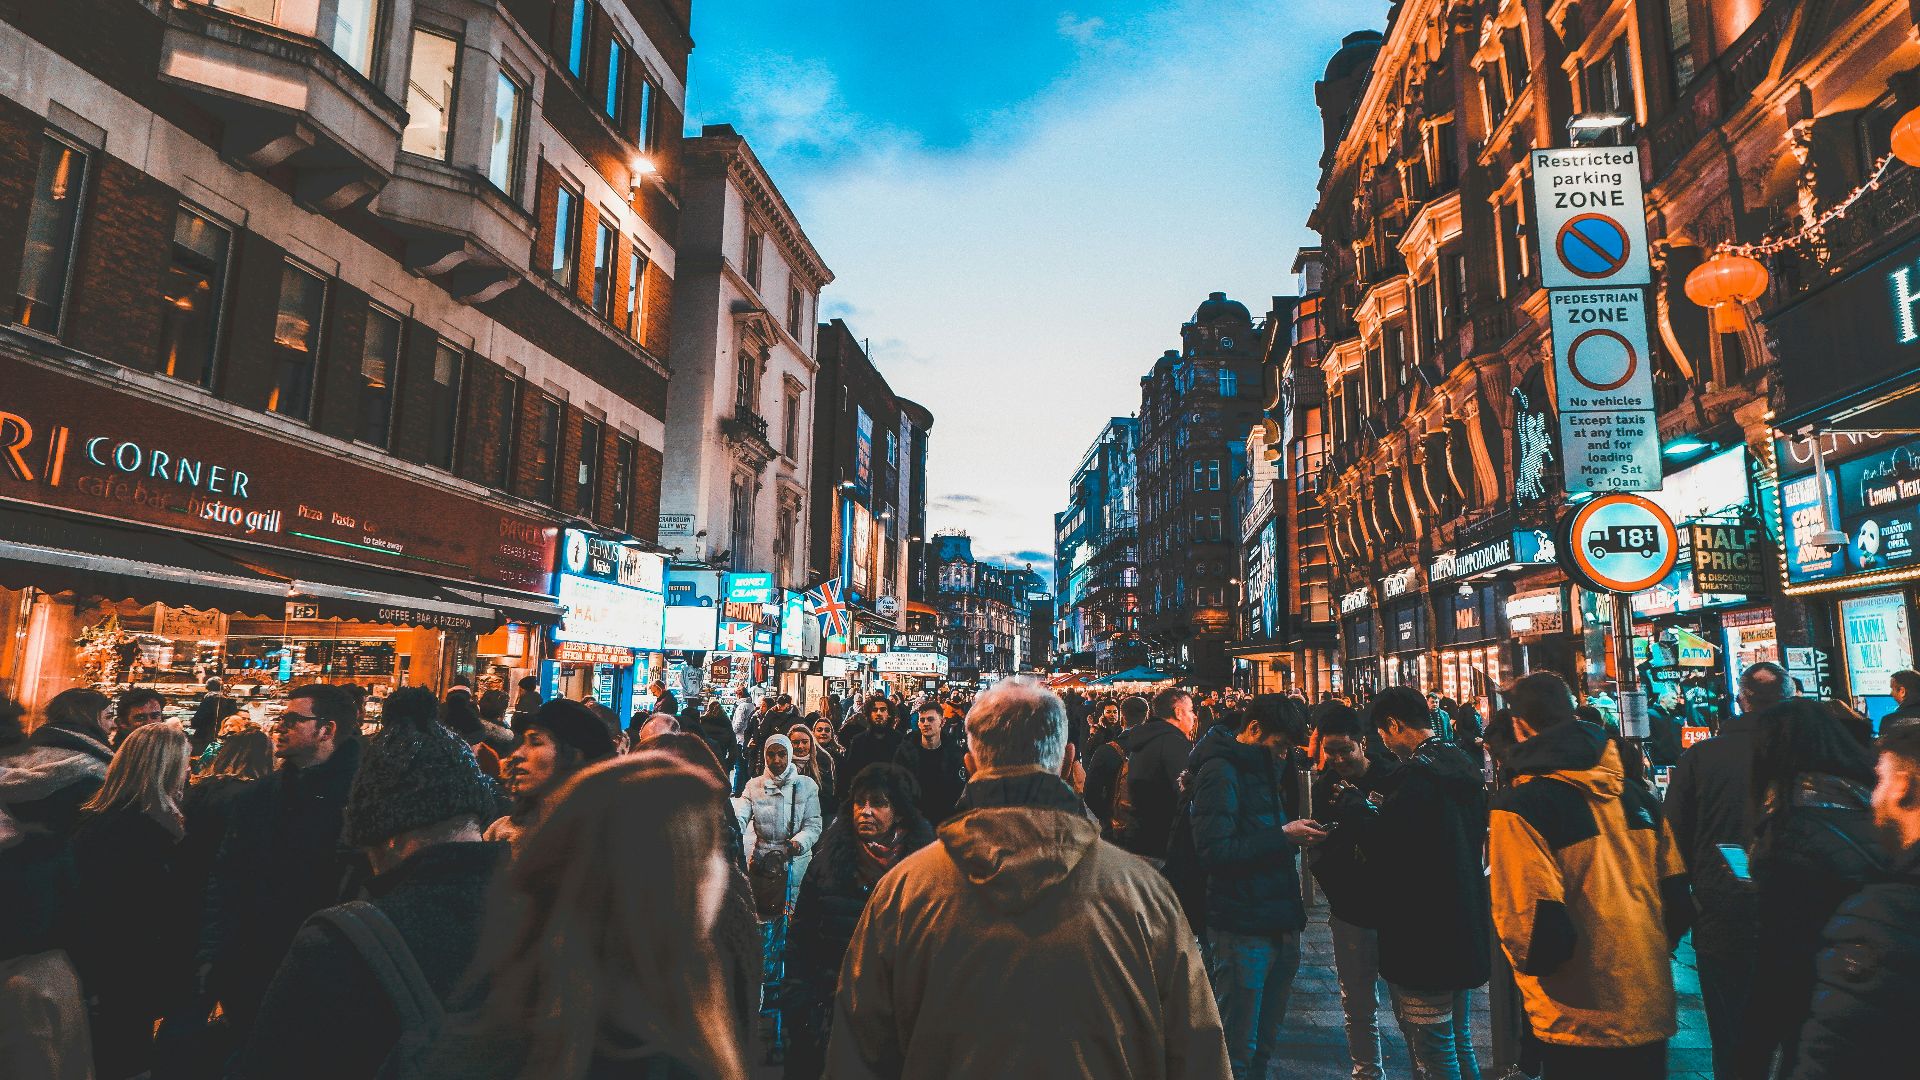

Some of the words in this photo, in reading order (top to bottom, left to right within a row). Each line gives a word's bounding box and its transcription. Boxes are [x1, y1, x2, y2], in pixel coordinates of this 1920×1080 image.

[1537, 150, 1634, 168] Restricted
[1553, 171, 1622, 188] parking
[1554, 190, 1625, 209] ZONE
[1555, 292, 1639, 305] PEDESTRIAN
[1568, 307, 1629, 324] ZONE
[1570, 397, 1588, 407] No
[1592, 396, 1642, 406] vehicles
[1569, 415, 1612, 427] Except
[1615, 414, 1646, 425] taxis
[1574, 429, 1587, 438] at
[1591, 429, 1612, 439] any
[1616, 428, 1644, 437] time
[1588, 440, 1610, 450] and
[1613, 440, 1632, 449] for
[86, 436, 249, 498] CORNER
[1588, 453, 1634, 464] loading
[1581, 466, 1608, 475] Mon
[1621, 465, 1642, 474] Sat
[1586, 478, 1594, 487] 6
[1607, 477, 1640, 487] 10am
[187, 495, 243, 526] bistro
[246, 509, 281, 534] grill
[298, 504, 323, 521] Pizza
[331, 511, 356, 529] Pasta
[1792, 505, 1824, 529] COM
[1881, 521, 1912, 536] PHANTOM
[363, 535, 371, 544] to
[371, 538, 387, 548] take
[386, 542, 404, 553] away
[1617, 528, 1653, 548] 18t
[1695, 527, 1757, 550] HALF
[1887, 538, 1909, 550] OPERA
[1456, 539, 1511, 577] HIPPODROME
[1697, 550, 1760, 570] PRICE
[1699, 573, 1706, 582] &
[1700, 582, 1733, 591] THEATRE
[379, 608, 410, 621] COFFEE
[416, 612, 431, 624] BAR
[440, 615, 471, 628] PIZZERIA
[726, 601, 762, 624] BRITAIN
[1741, 630, 1756, 641] ATM
[1756, 628, 1774, 639] HERE
[1849, 618, 1888, 644] MAMMA
[1681, 647, 1712, 659] ATM
[1657, 670, 1681, 680] QUEEN
